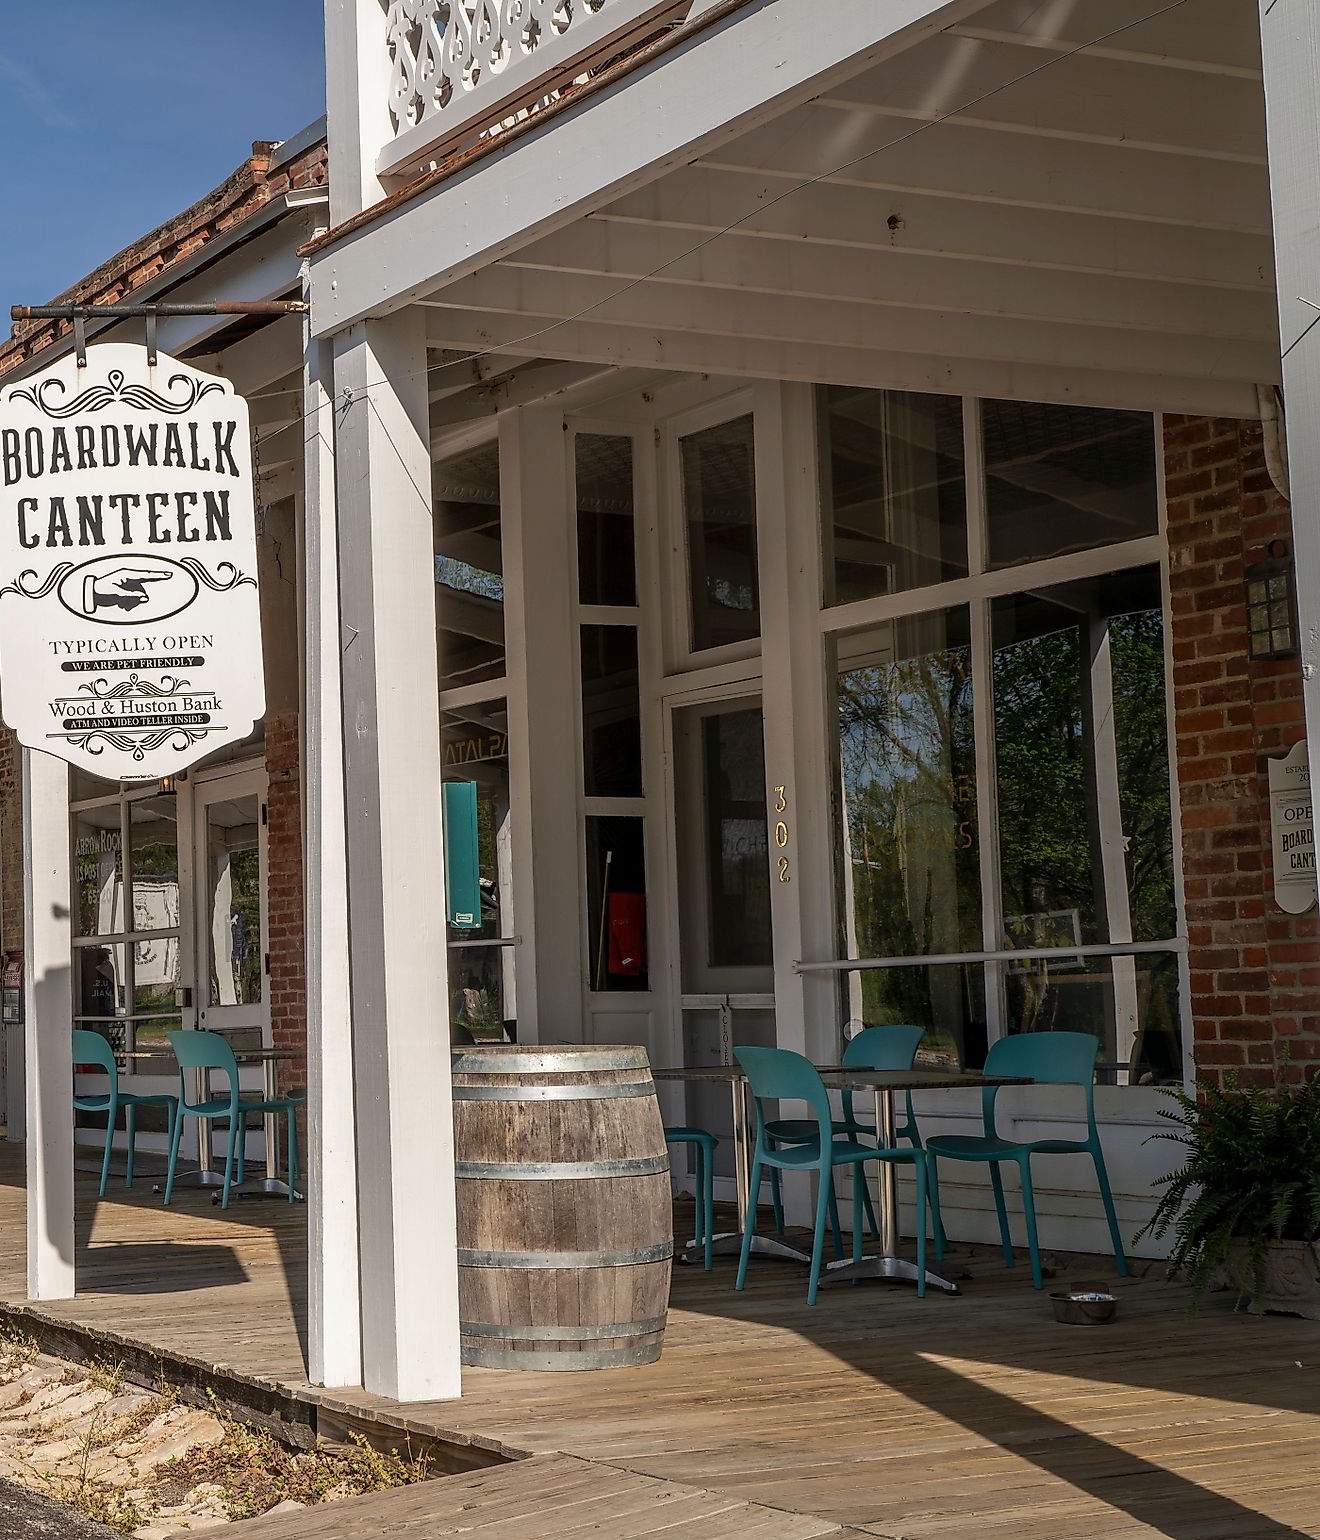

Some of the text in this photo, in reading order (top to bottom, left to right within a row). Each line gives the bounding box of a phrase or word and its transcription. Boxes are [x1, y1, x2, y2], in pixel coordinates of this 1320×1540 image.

[2, 421, 240, 486] BOARDWALK
[17, 490, 233, 549] CANTEEN
[49, 634, 214, 654] TYPICALLY OPEN
[72, 657, 194, 671] WE ARE PET FRIENDLY
[48, 696, 223, 718] Wood & Huston Bank
[70, 714, 204, 729] ATM AND VIDEO TELLER INSIDE
[1284, 806, 1313, 821] OPE
[774, 785, 791, 883] 302
[1282, 829, 1313, 852] BOARD
[1291, 853, 1315, 869] CANT
